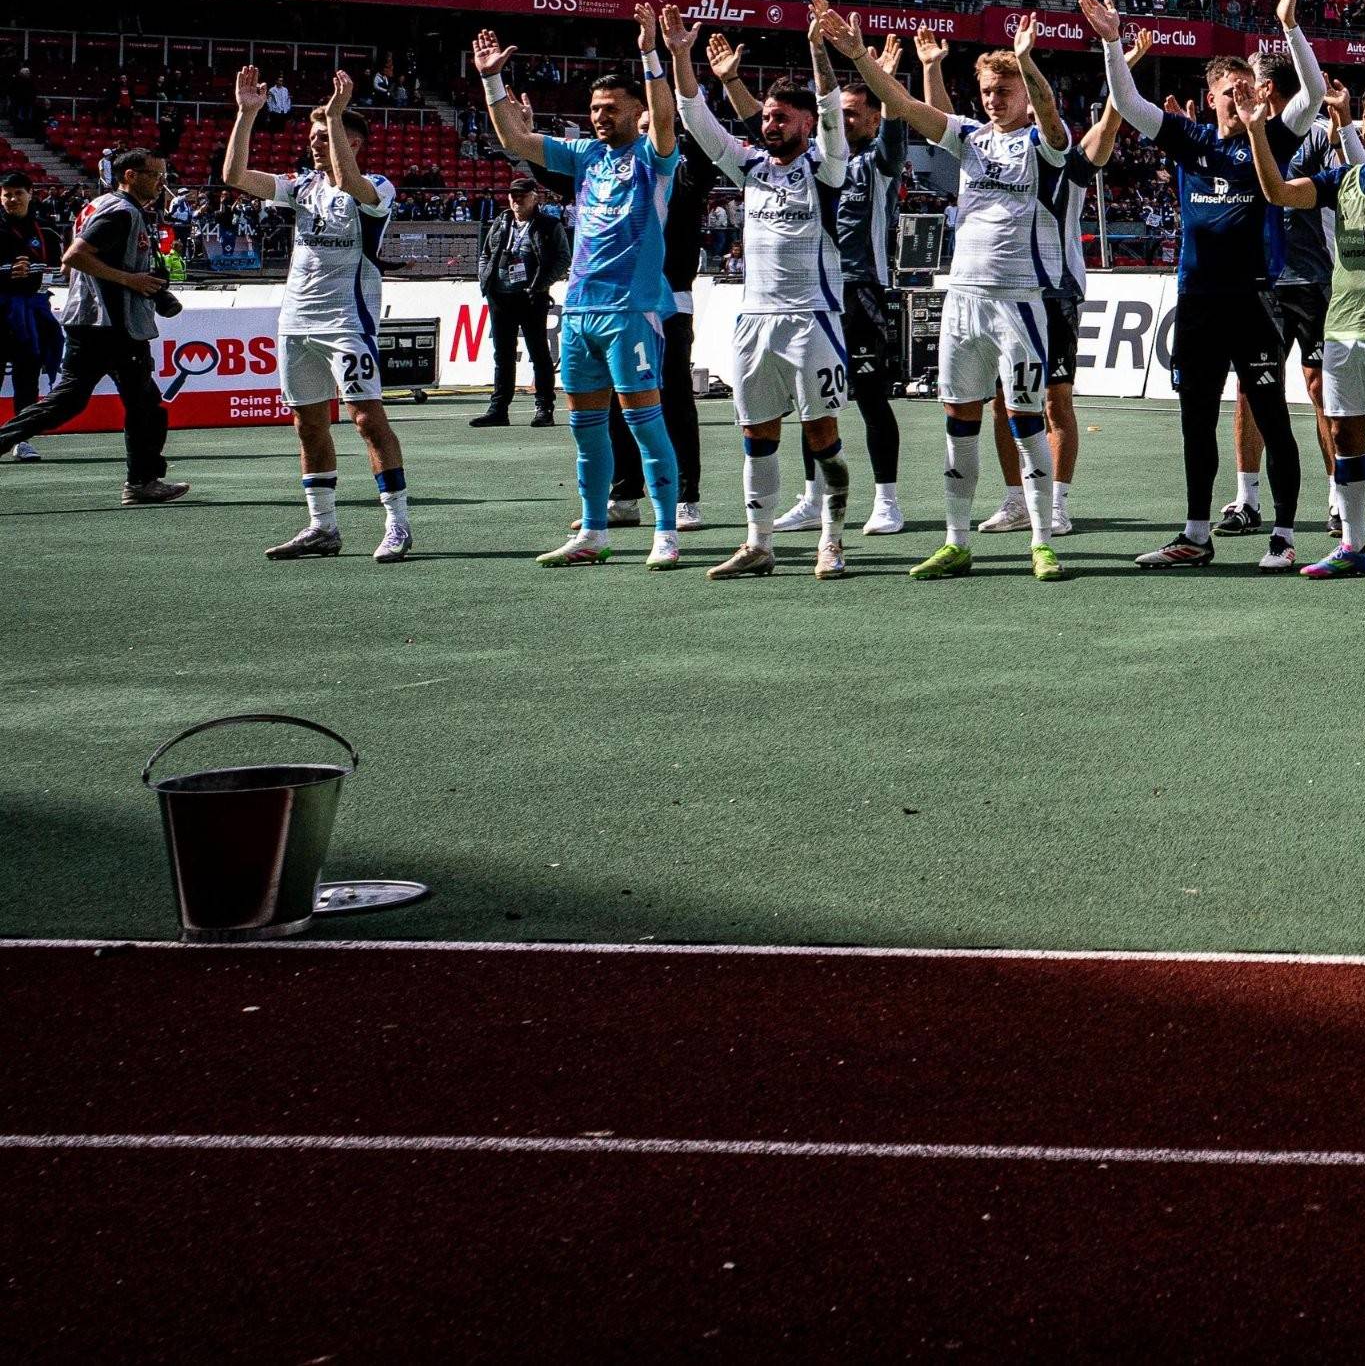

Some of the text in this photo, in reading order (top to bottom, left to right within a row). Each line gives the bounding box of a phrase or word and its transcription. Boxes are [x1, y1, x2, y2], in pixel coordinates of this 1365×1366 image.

[680, 0, 756, 21] nibler
[869, 15, 955, 33] HELMSAUER
[1036, 21, 1084, 39] Der Club
[1152, 29, 1197, 46] Der Club
[1190, 192, 1255, 204] HanseMerkur
[633, 341, 651, 372] 1
[343, 352, 374, 382] 29
[817, 365, 845, 399] 20
[1013, 361, 1043, 393] 17
[230, 395, 268, 406] Deine
[230, 407, 291, 419] Deine JO
